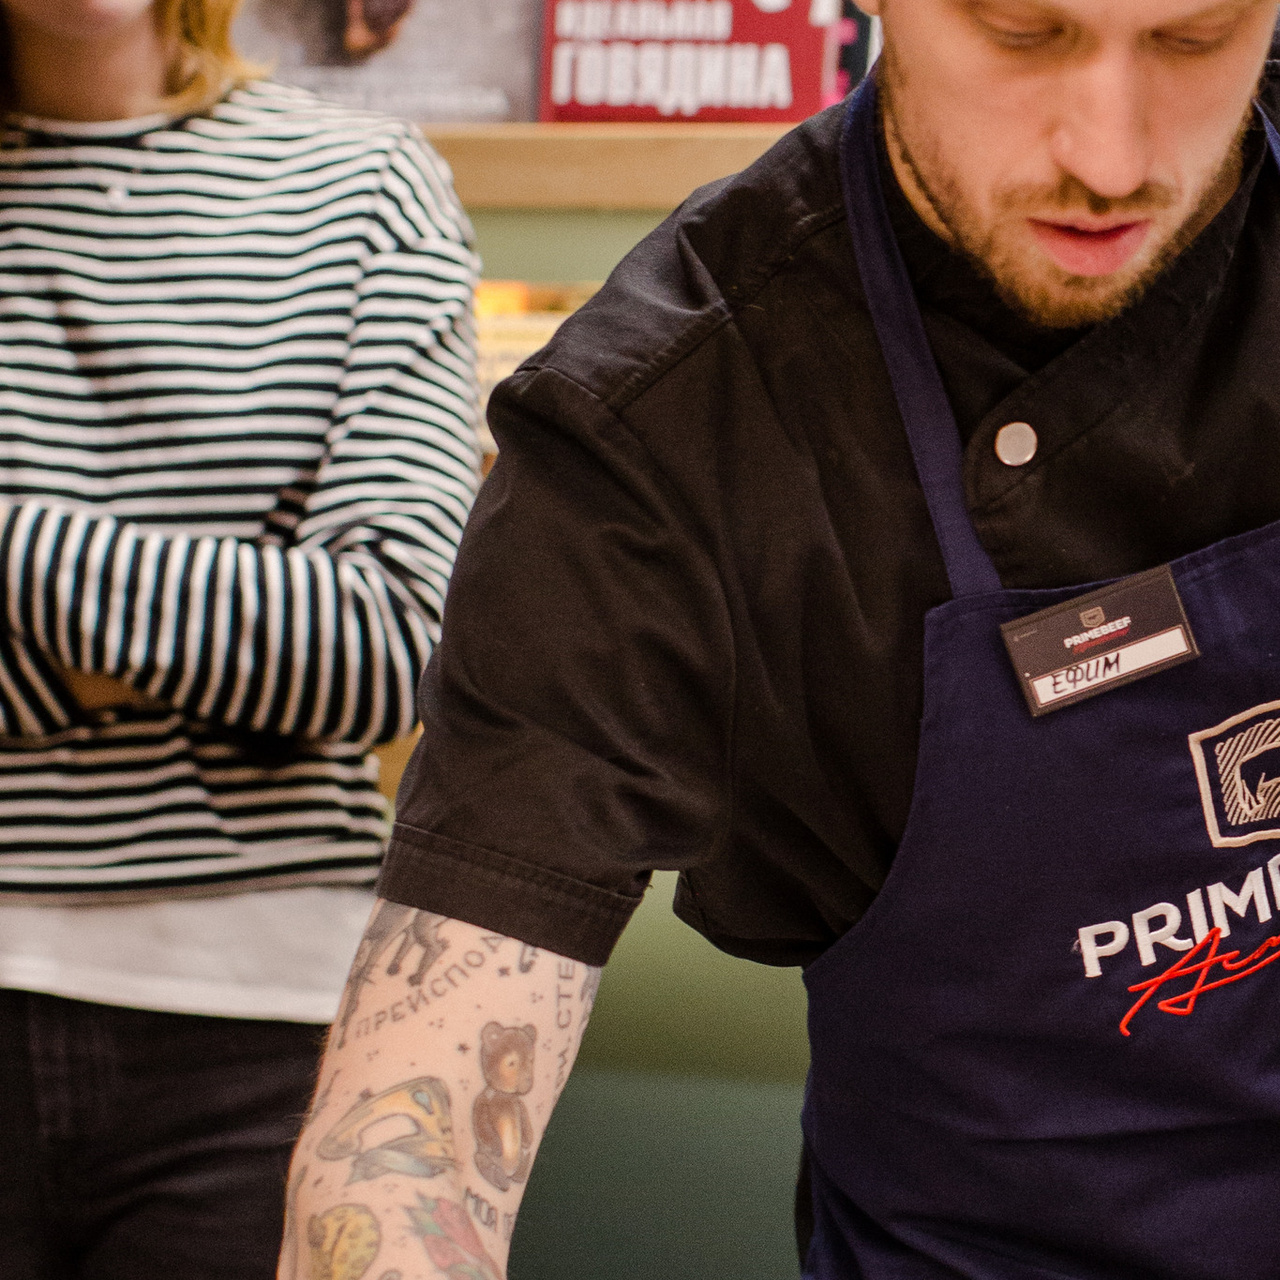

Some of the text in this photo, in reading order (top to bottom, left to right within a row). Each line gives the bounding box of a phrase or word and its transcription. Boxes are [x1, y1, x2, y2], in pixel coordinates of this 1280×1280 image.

[551, 41, 794, 117] ГОВЯДИНА
[1063, 616, 1132, 649] PRIMEBEEF
[1050, 652, 1121, 695] ЕФИМ
